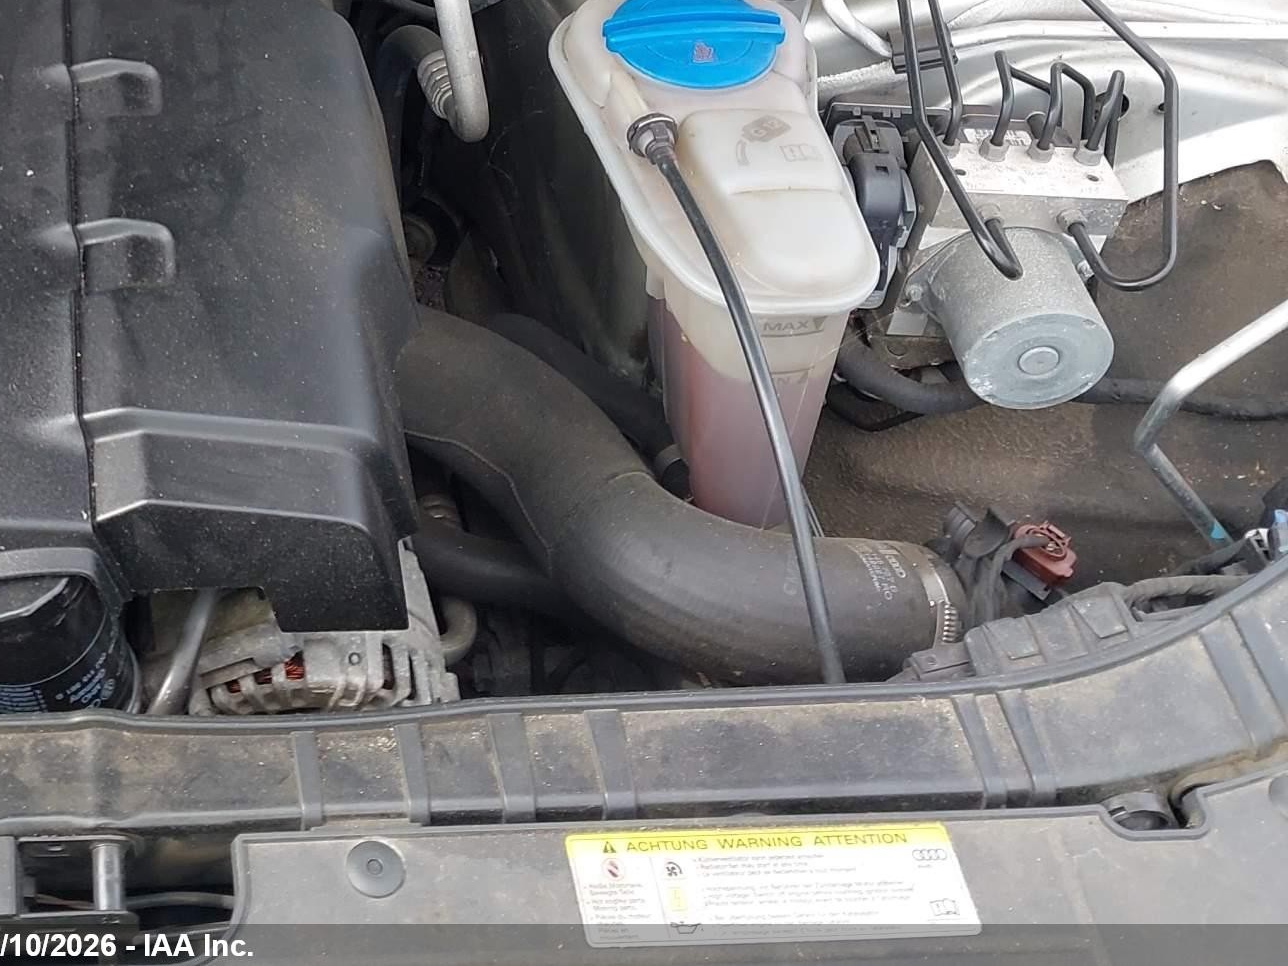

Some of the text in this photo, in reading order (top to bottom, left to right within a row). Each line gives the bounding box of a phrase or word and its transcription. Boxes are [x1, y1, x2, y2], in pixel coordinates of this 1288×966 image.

[763, 320, 809, 331] MAX
[626, 832, 907, 852] ACHTUNG WARNING ATTENTION
